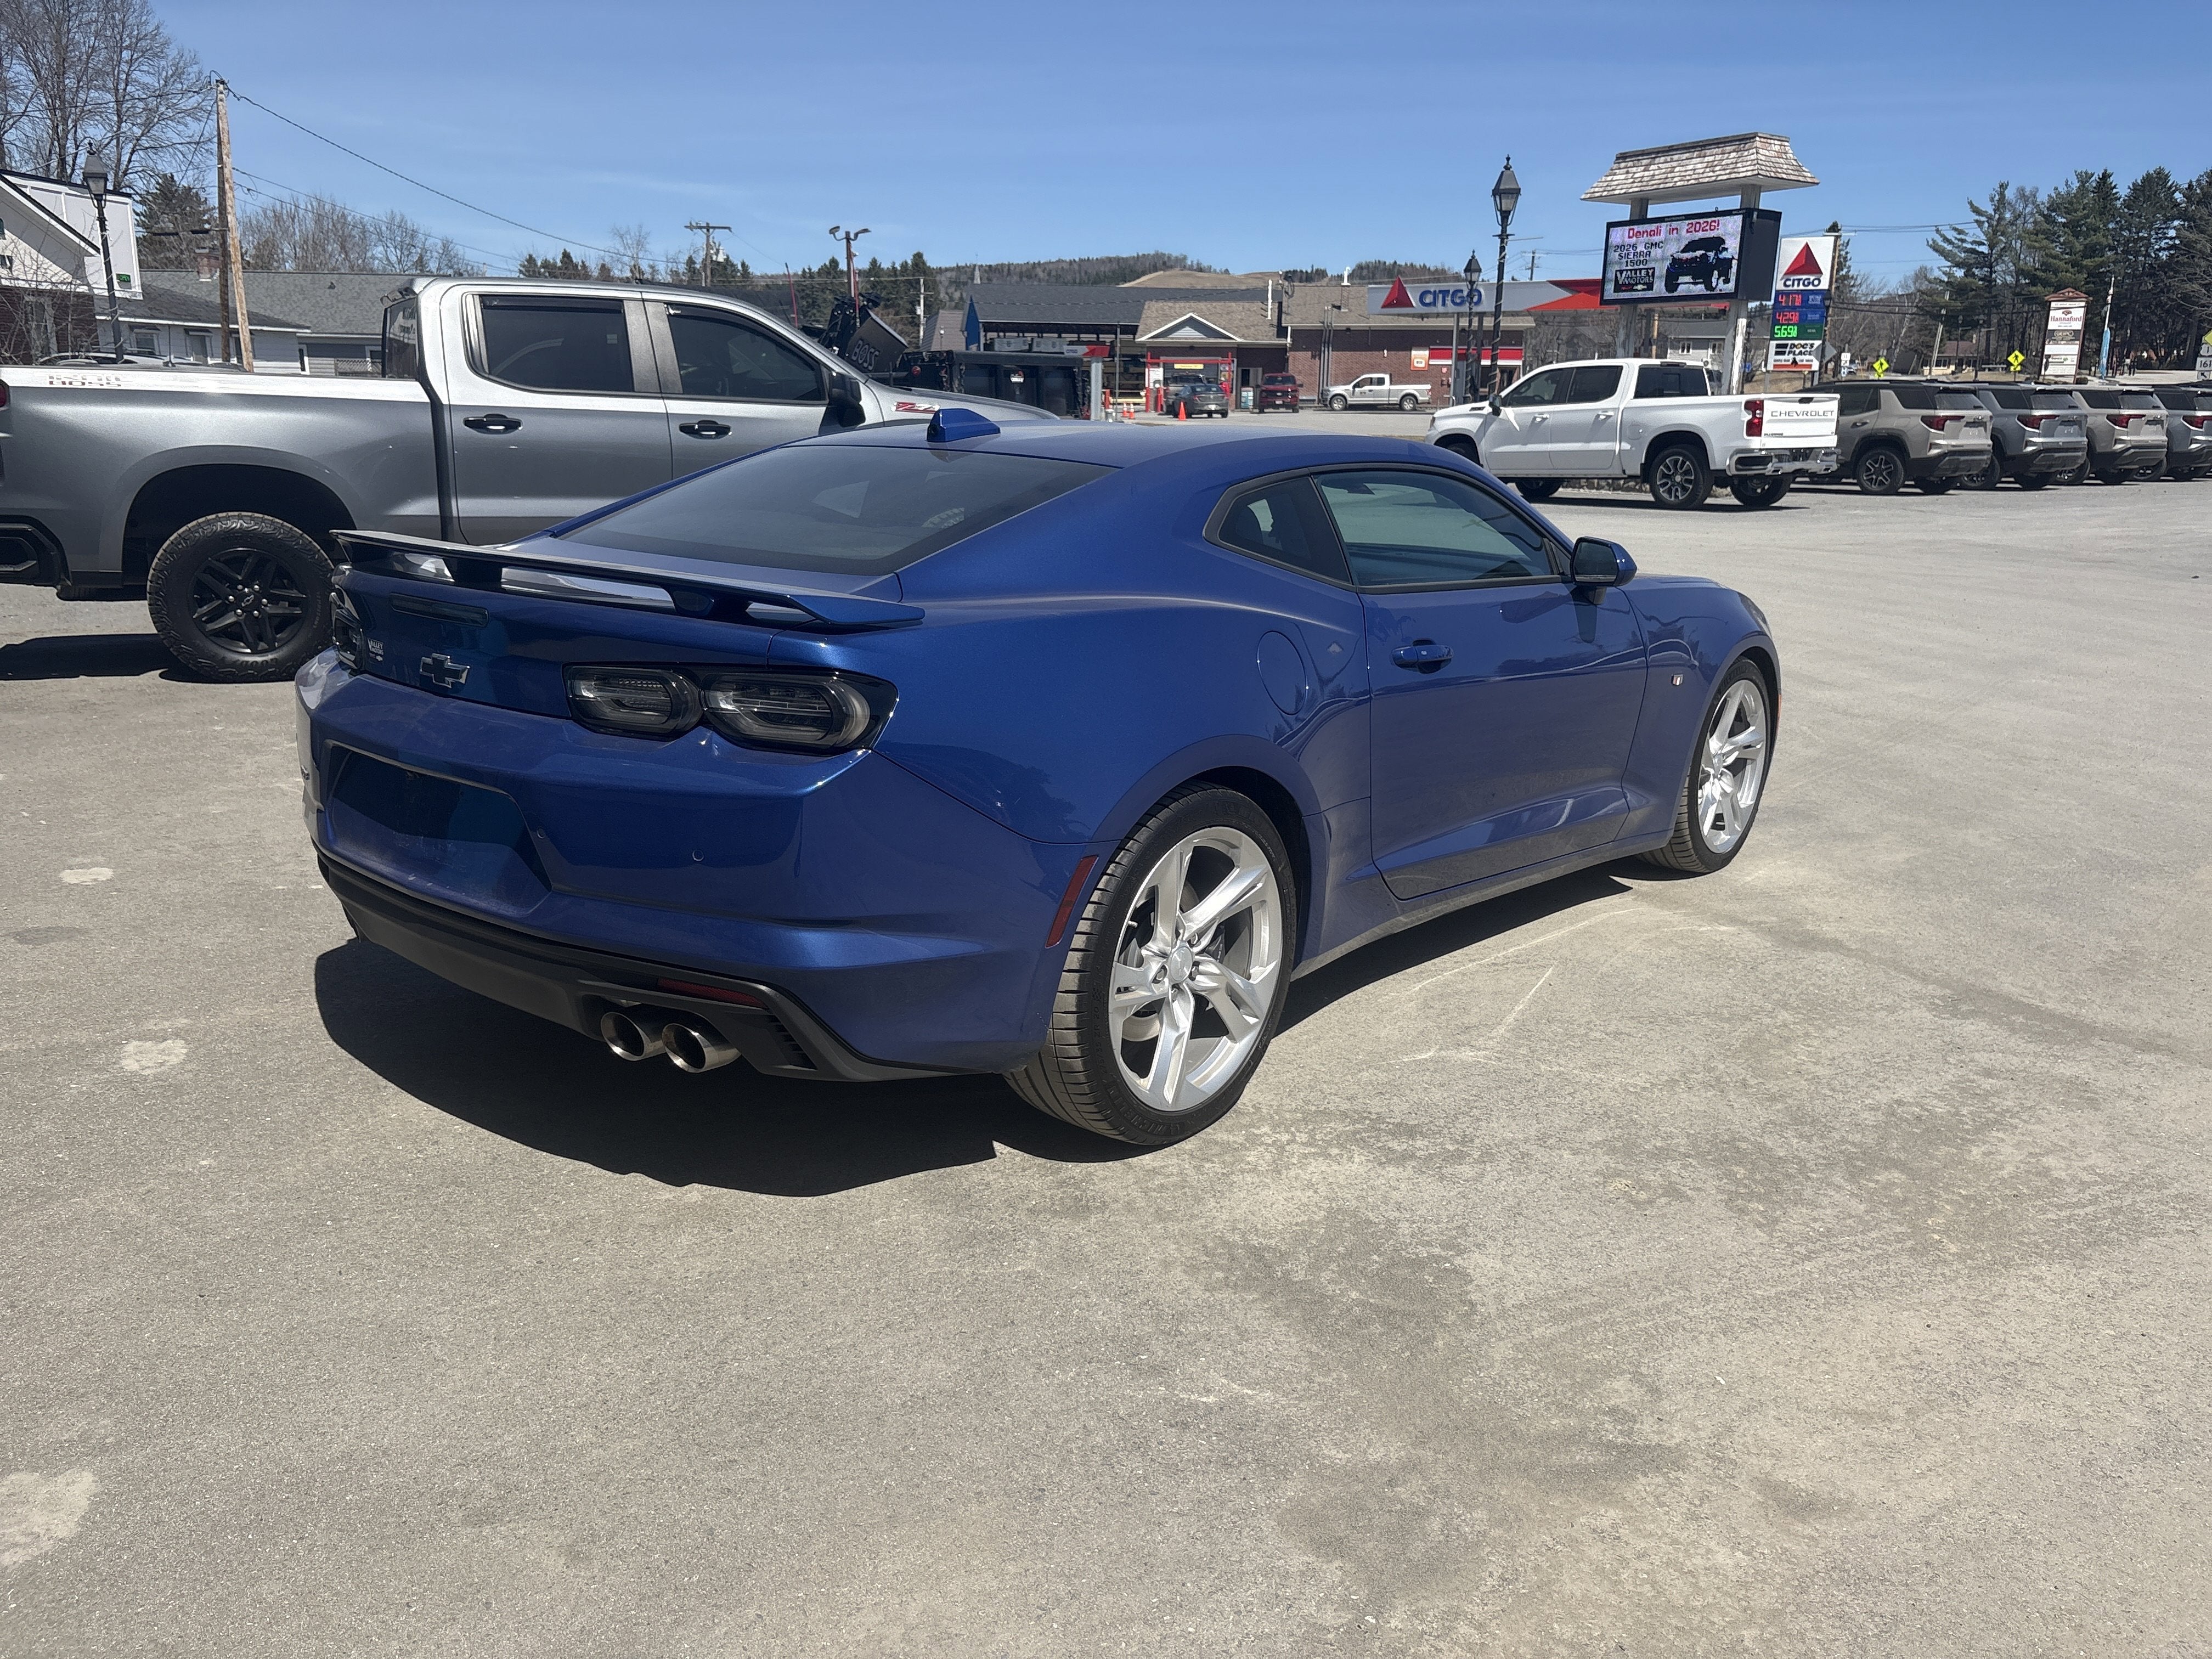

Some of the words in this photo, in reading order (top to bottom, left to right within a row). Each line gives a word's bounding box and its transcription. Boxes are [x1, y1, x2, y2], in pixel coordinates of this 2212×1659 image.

[1627, 225, 1662, 239] Denali
[1668, 224, 1679, 235] in
[1686, 219, 1720, 234] 2026!
[1613, 244, 1638, 253] 2026
[1644, 241, 1664, 250] GMC
[1618, 251, 1651, 260] SIERRA
[1624, 259, 1648, 267] 1500
[1616, 269, 1654, 285] VALLEY
[1783, 278, 1821, 288] CITGO
[1419, 289, 1482, 308] CITGO
[851, 340, 879, 371] BOSS
[2199, 360, 2212, 368] 161
[368, 639, 383, 651] VALLEY
